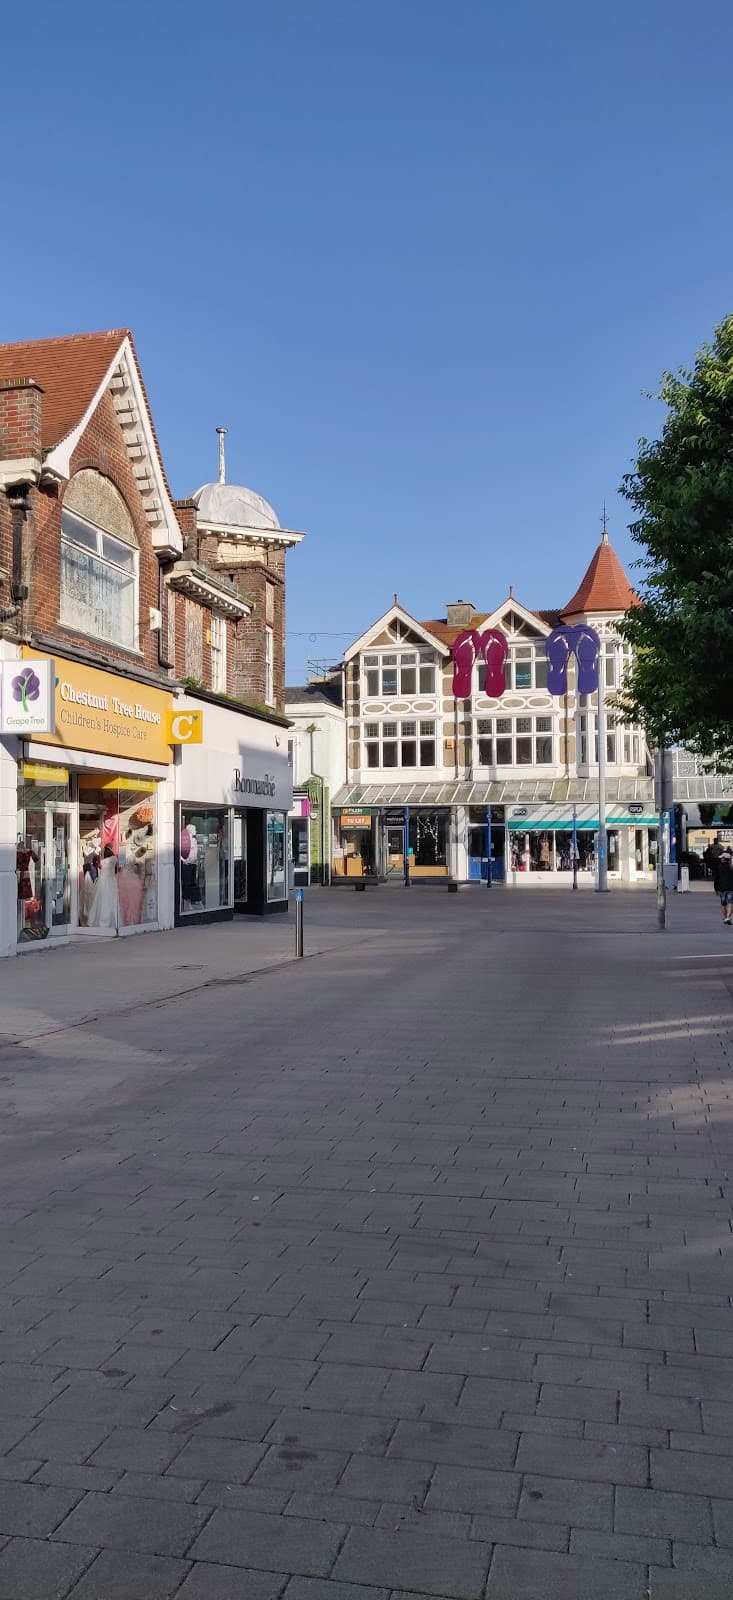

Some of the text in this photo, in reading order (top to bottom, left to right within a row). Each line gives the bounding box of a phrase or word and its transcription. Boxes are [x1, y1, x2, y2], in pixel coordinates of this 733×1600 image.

[60, 682, 161, 724] Chestnut Tree House
[6, 716, 45, 727] Grape Tree
[60, 709, 147, 741] Children's Hospice Care
[171, 715, 193, 740] C
